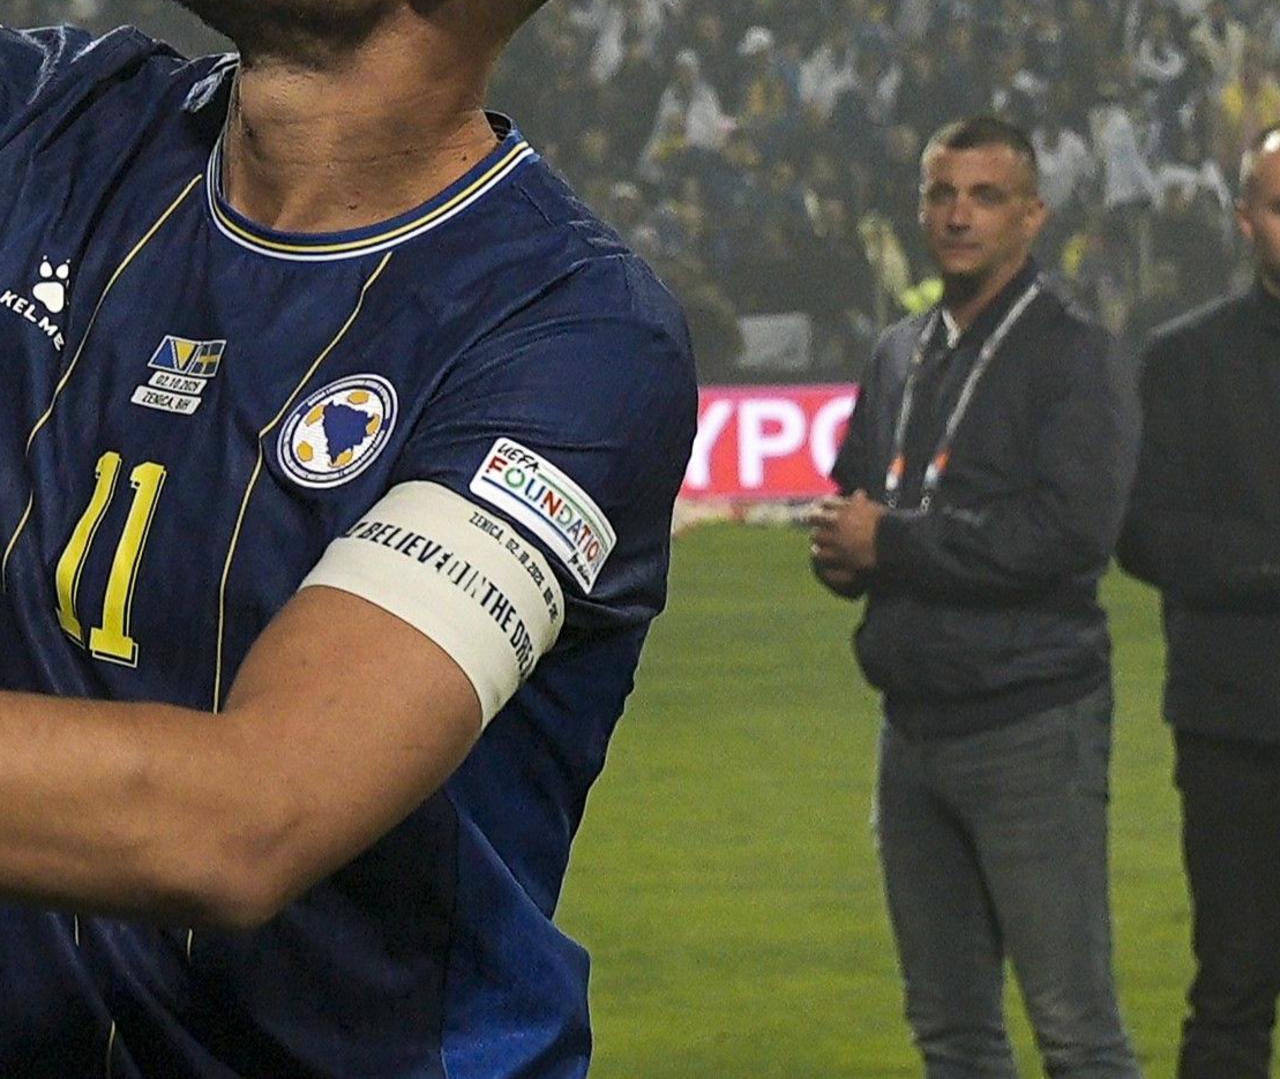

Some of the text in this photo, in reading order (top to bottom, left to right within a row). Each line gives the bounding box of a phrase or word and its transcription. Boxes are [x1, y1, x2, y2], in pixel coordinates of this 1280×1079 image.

[497, 442, 540, 473] UEFA
[55, 450, 168, 668] 11
[479, 581, 517, 633] THE
